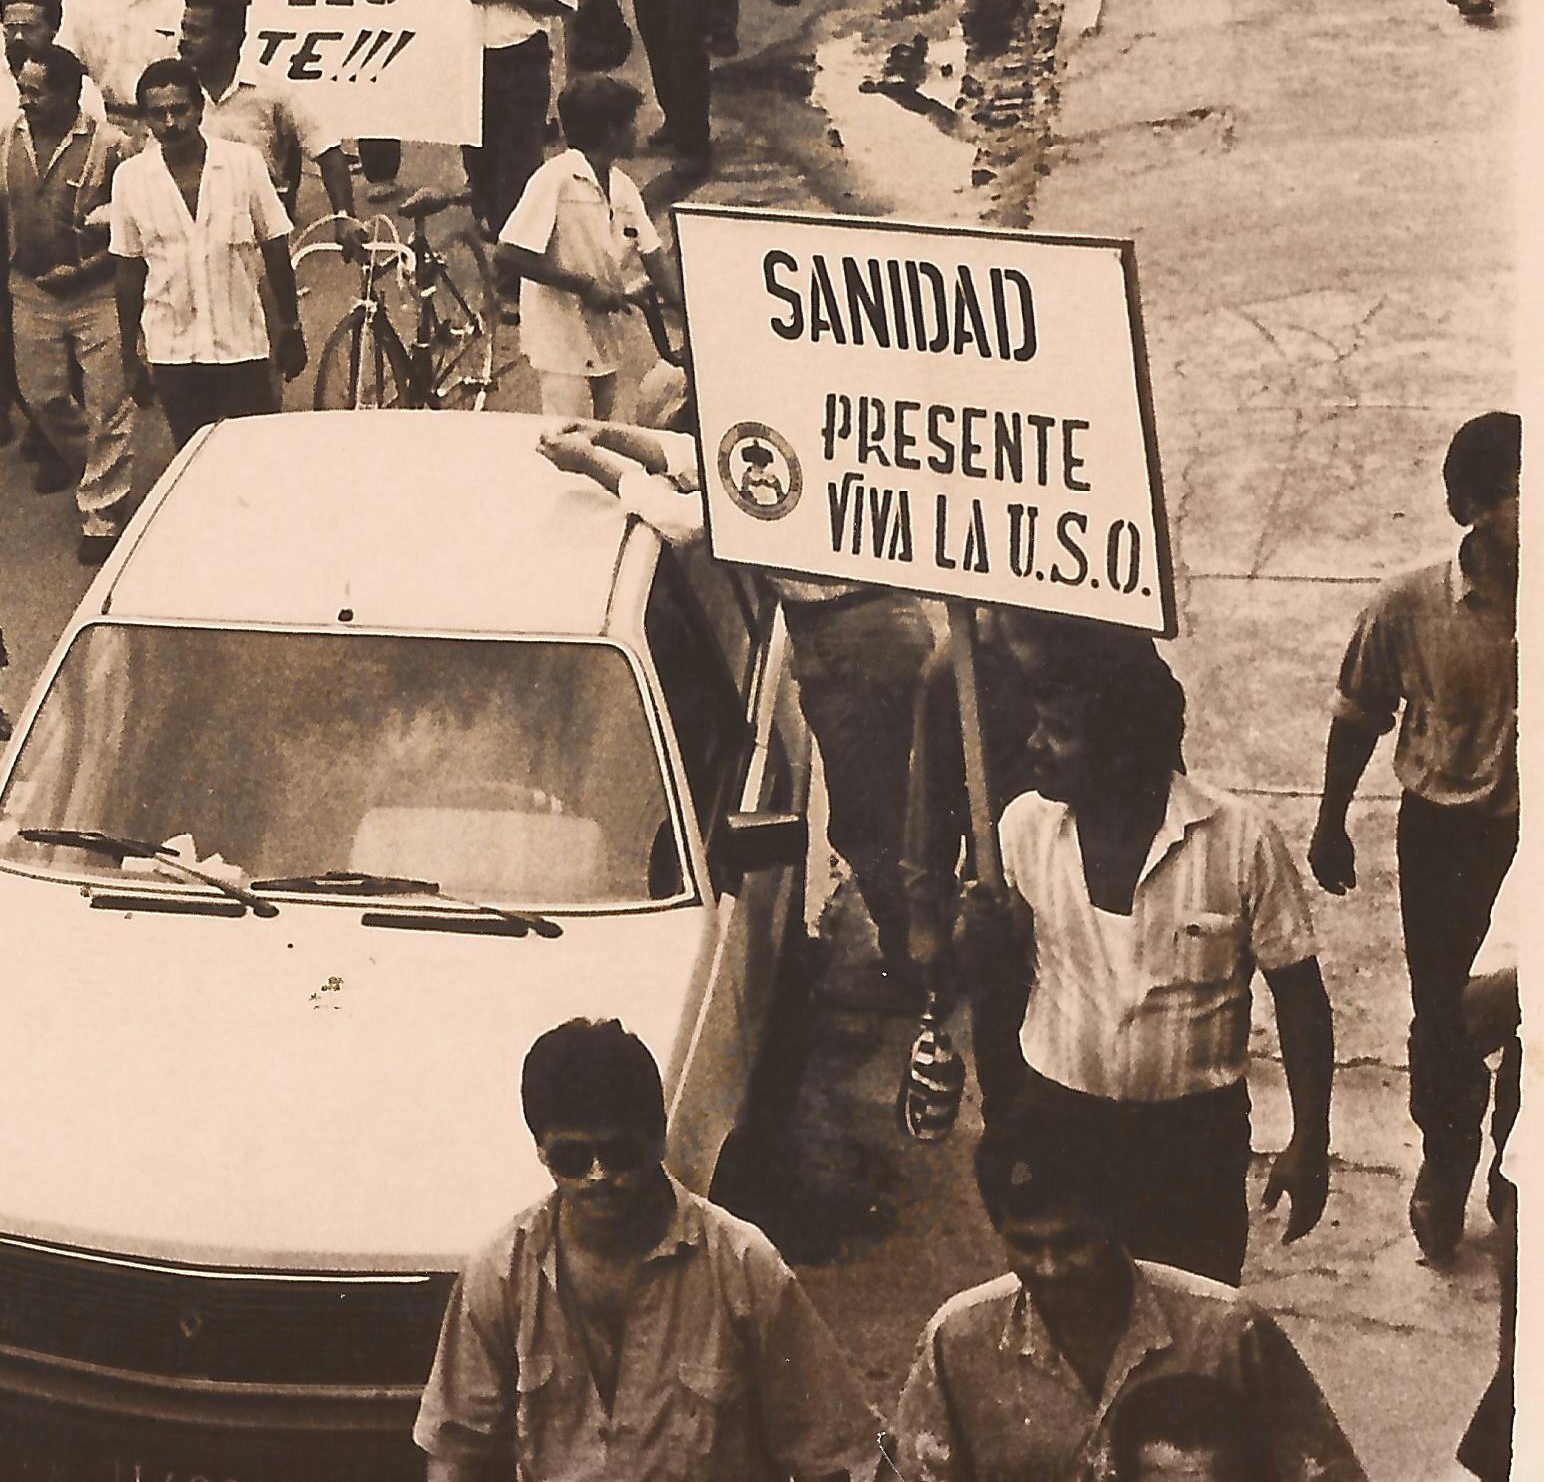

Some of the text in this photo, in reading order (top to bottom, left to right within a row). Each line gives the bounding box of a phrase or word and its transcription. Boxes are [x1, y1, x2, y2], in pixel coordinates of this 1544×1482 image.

[762, 248, 1038, 363] SANIDAD
[821, 392, 1092, 493] PRESENTE
[827, 471, 1152, 599] VIVA LA U.S.O.
